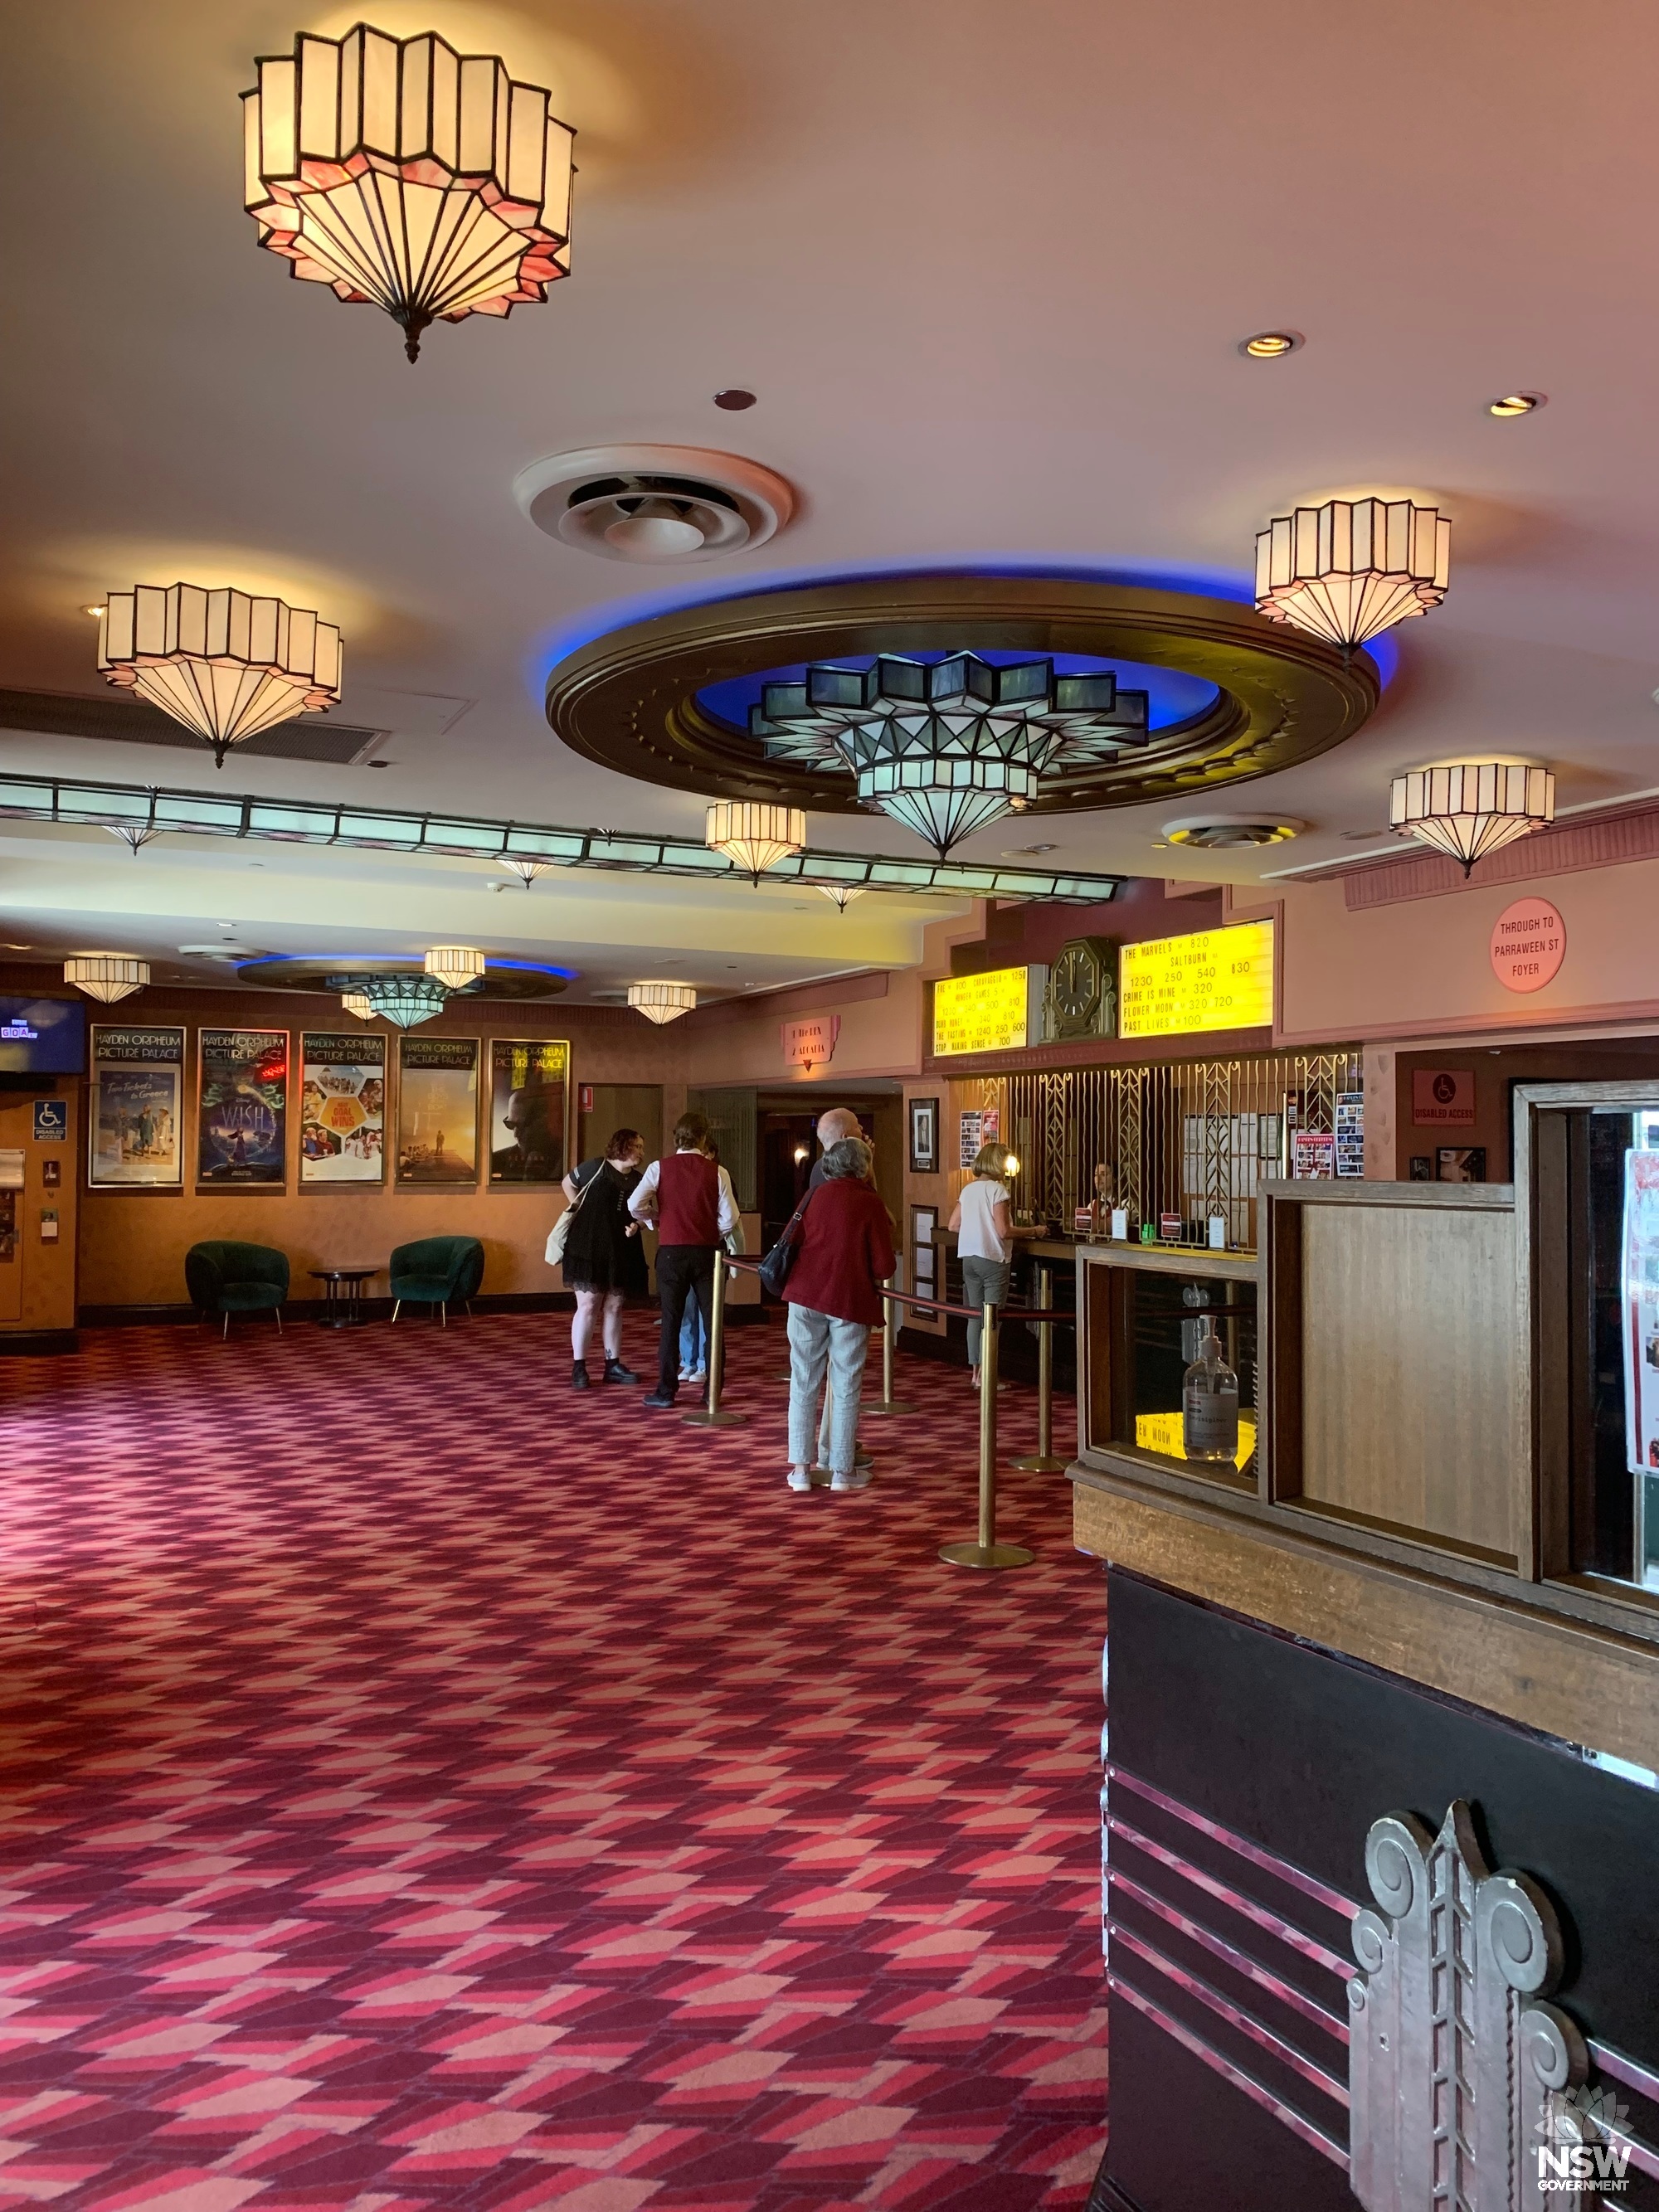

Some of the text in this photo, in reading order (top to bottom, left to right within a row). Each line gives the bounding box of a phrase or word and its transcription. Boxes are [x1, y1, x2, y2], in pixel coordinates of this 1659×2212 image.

[1501, 916, 1554, 934] THROUGH TO
[1125, 948, 1136, 960] THE
[1141, 942, 1172, 957] MARVELS
[1190, 936, 1209, 949] 820
[1495, 938, 1559, 957] PARRAWEEN ST
[1170, 952, 1207, 967] SALTBURN
[1130, 961, 1250, 987] 1230 250 540 830
[1512, 963, 1540, 977] FOYER
[1123, 990, 1143, 1004] CRIME
[1147, 989, 1155, 1000] IS
[1158, 987, 1175, 999] MINE
[1193, 982, 1213, 994] 320
[1123, 1004, 1151, 1018] FLOWER
[1155, 1002, 1174, 1014] MOON
[1189, 998, 1208, 1010] 320
[1214, 995, 1233, 1008] 720
[1012, 1022, 1026, 1032] 600
[1124, 1019, 1141, 1033] PAST
[1146, 1018, 1170, 1030] LIVES
[1183, 1014, 1202, 1027] 100
[95, 1034, 181, 1046] HAYDEN ORPHEUM
[202, 1036, 285, 1048] HAYDEN ORPHEUM
[304, 1038, 383, 1050] HAYDEN ORPHEUM
[98, 1047, 178, 1059] PICTURE PALACE
[205, 1048, 282, 1061] PICTURE PALACE
[306, 1050, 381, 1062] PICTURE PALACE
[221, 1104, 264, 1130] WISH
[333, 1107, 353, 1116] GOAL
[1415, 1108, 1473, 1119] DISABLED ACCESS
[331, 1116, 355, 1127] WINS
